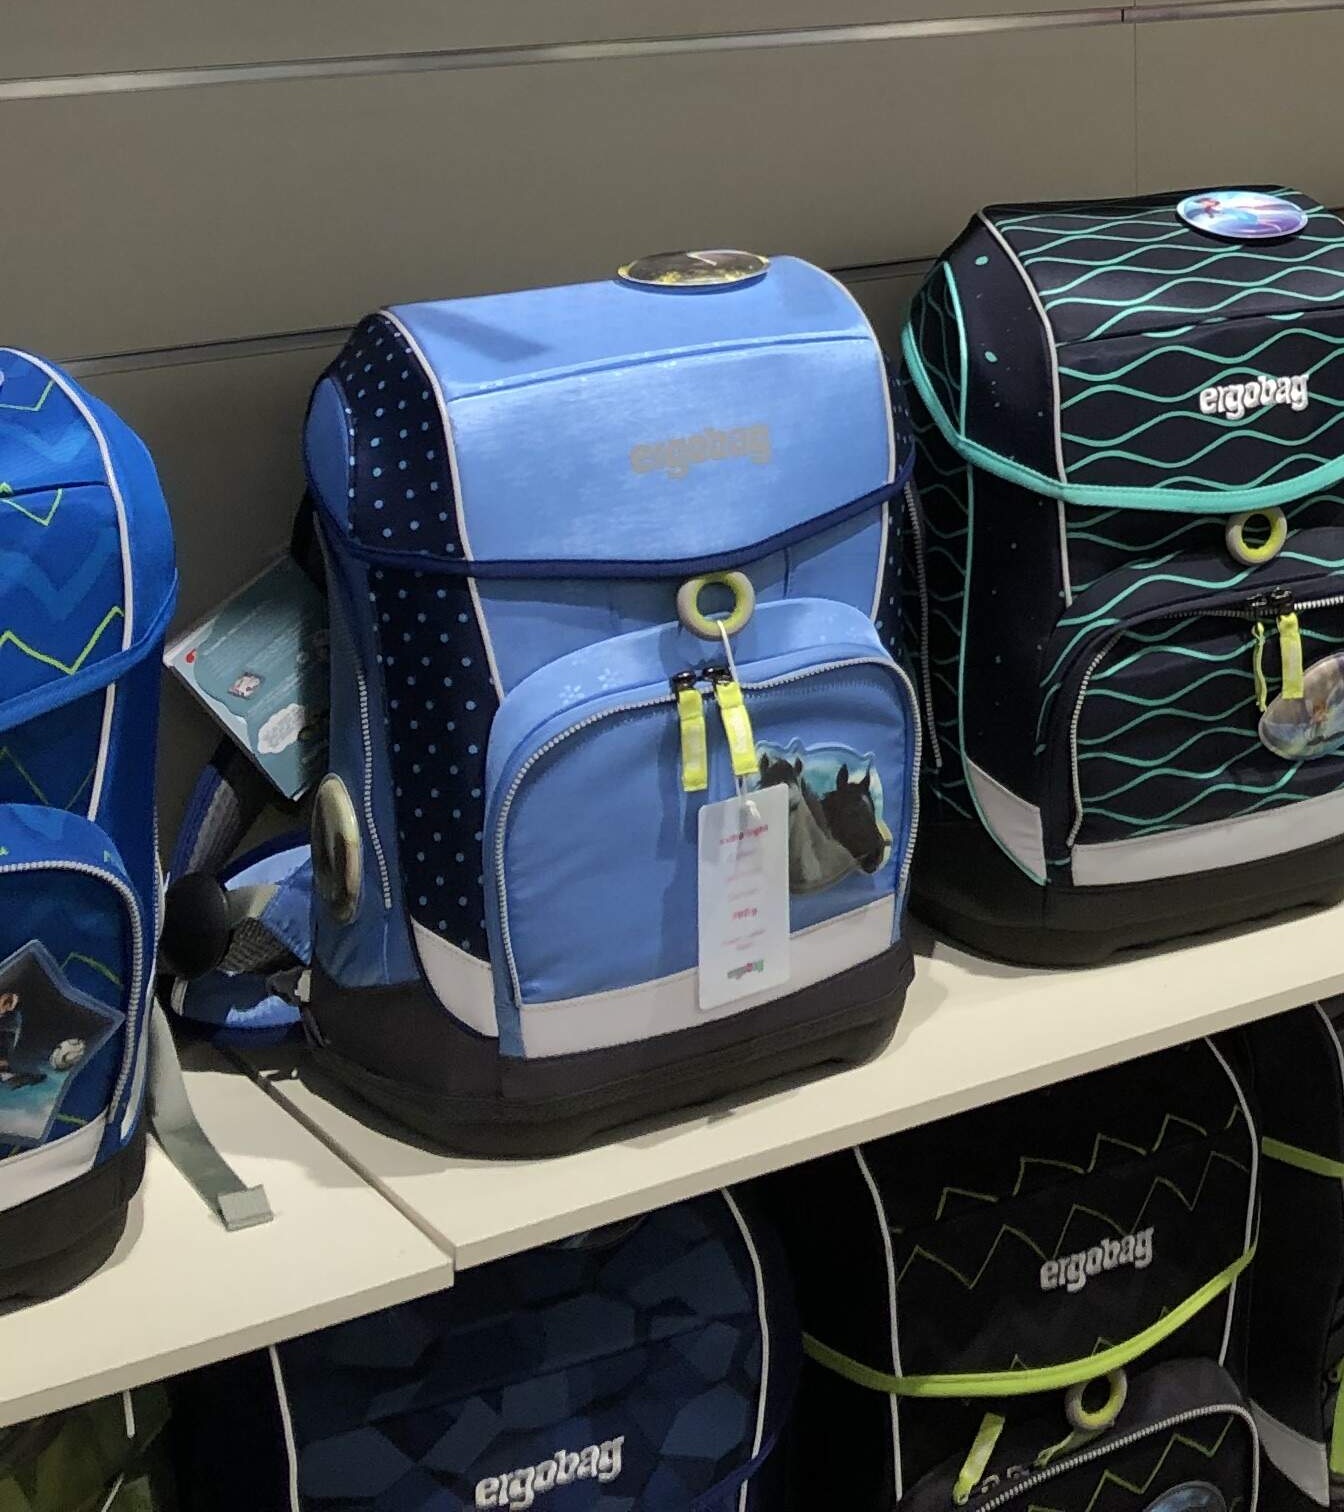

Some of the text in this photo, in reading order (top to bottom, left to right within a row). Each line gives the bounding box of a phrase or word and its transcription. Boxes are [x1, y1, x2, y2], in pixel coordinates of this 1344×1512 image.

[1199, 373, 1310, 419] ergobag
[629, 422, 772, 478] ergobag
[1039, 1225, 1154, 1293] ergobag
[475, 1433, 625, 1512] ergobag
